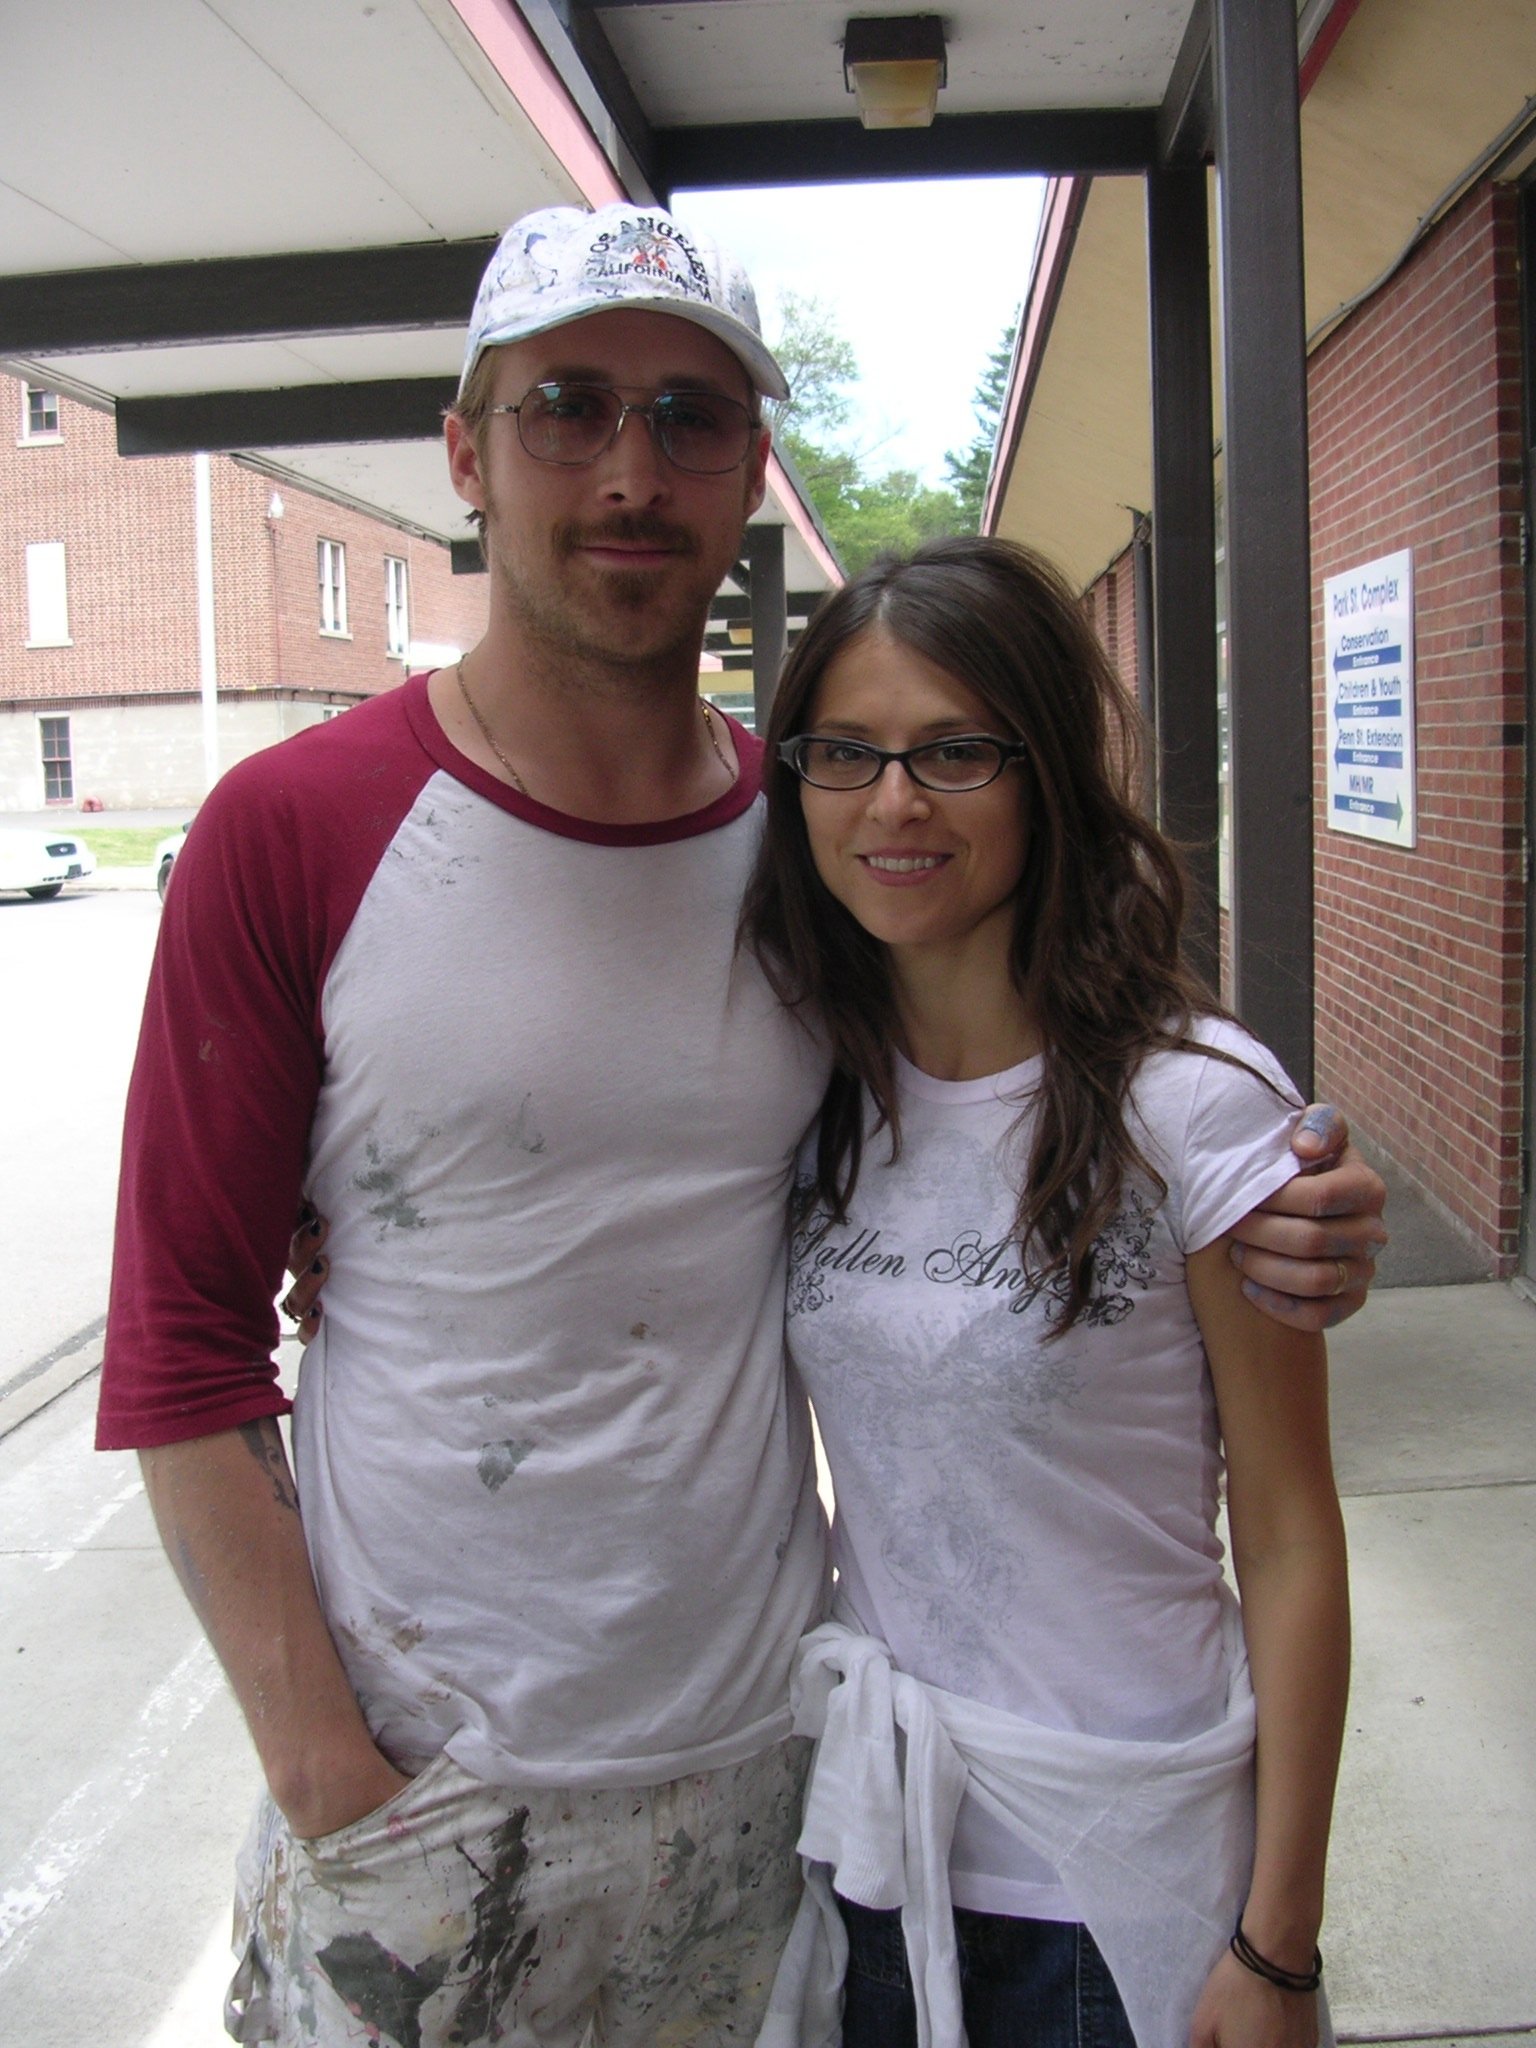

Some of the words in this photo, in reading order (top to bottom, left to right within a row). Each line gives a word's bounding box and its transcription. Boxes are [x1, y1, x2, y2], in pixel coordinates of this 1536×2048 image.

[620, 216, 709, 286] ANGELES
[1333, 591, 1349, 618] Park
[1361, 575, 1399, 612] Complex
[1341, 627, 1389, 652] Conservation
[1352, 654, 1379, 669] Entrance
[1339, 680, 1369, 700] Children
[1371, 677, 1377, 697] &
[1379, 675, 1401, 697] Youth
[1352, 703, 1379, 716] Entrance
[1338, 728, 1355, 746] Penn
[1367, 726, 1403, 748] Extension
[1352, 751, 1379, 765] Entrance
[923, 1229, 1084, 1315] Ange
